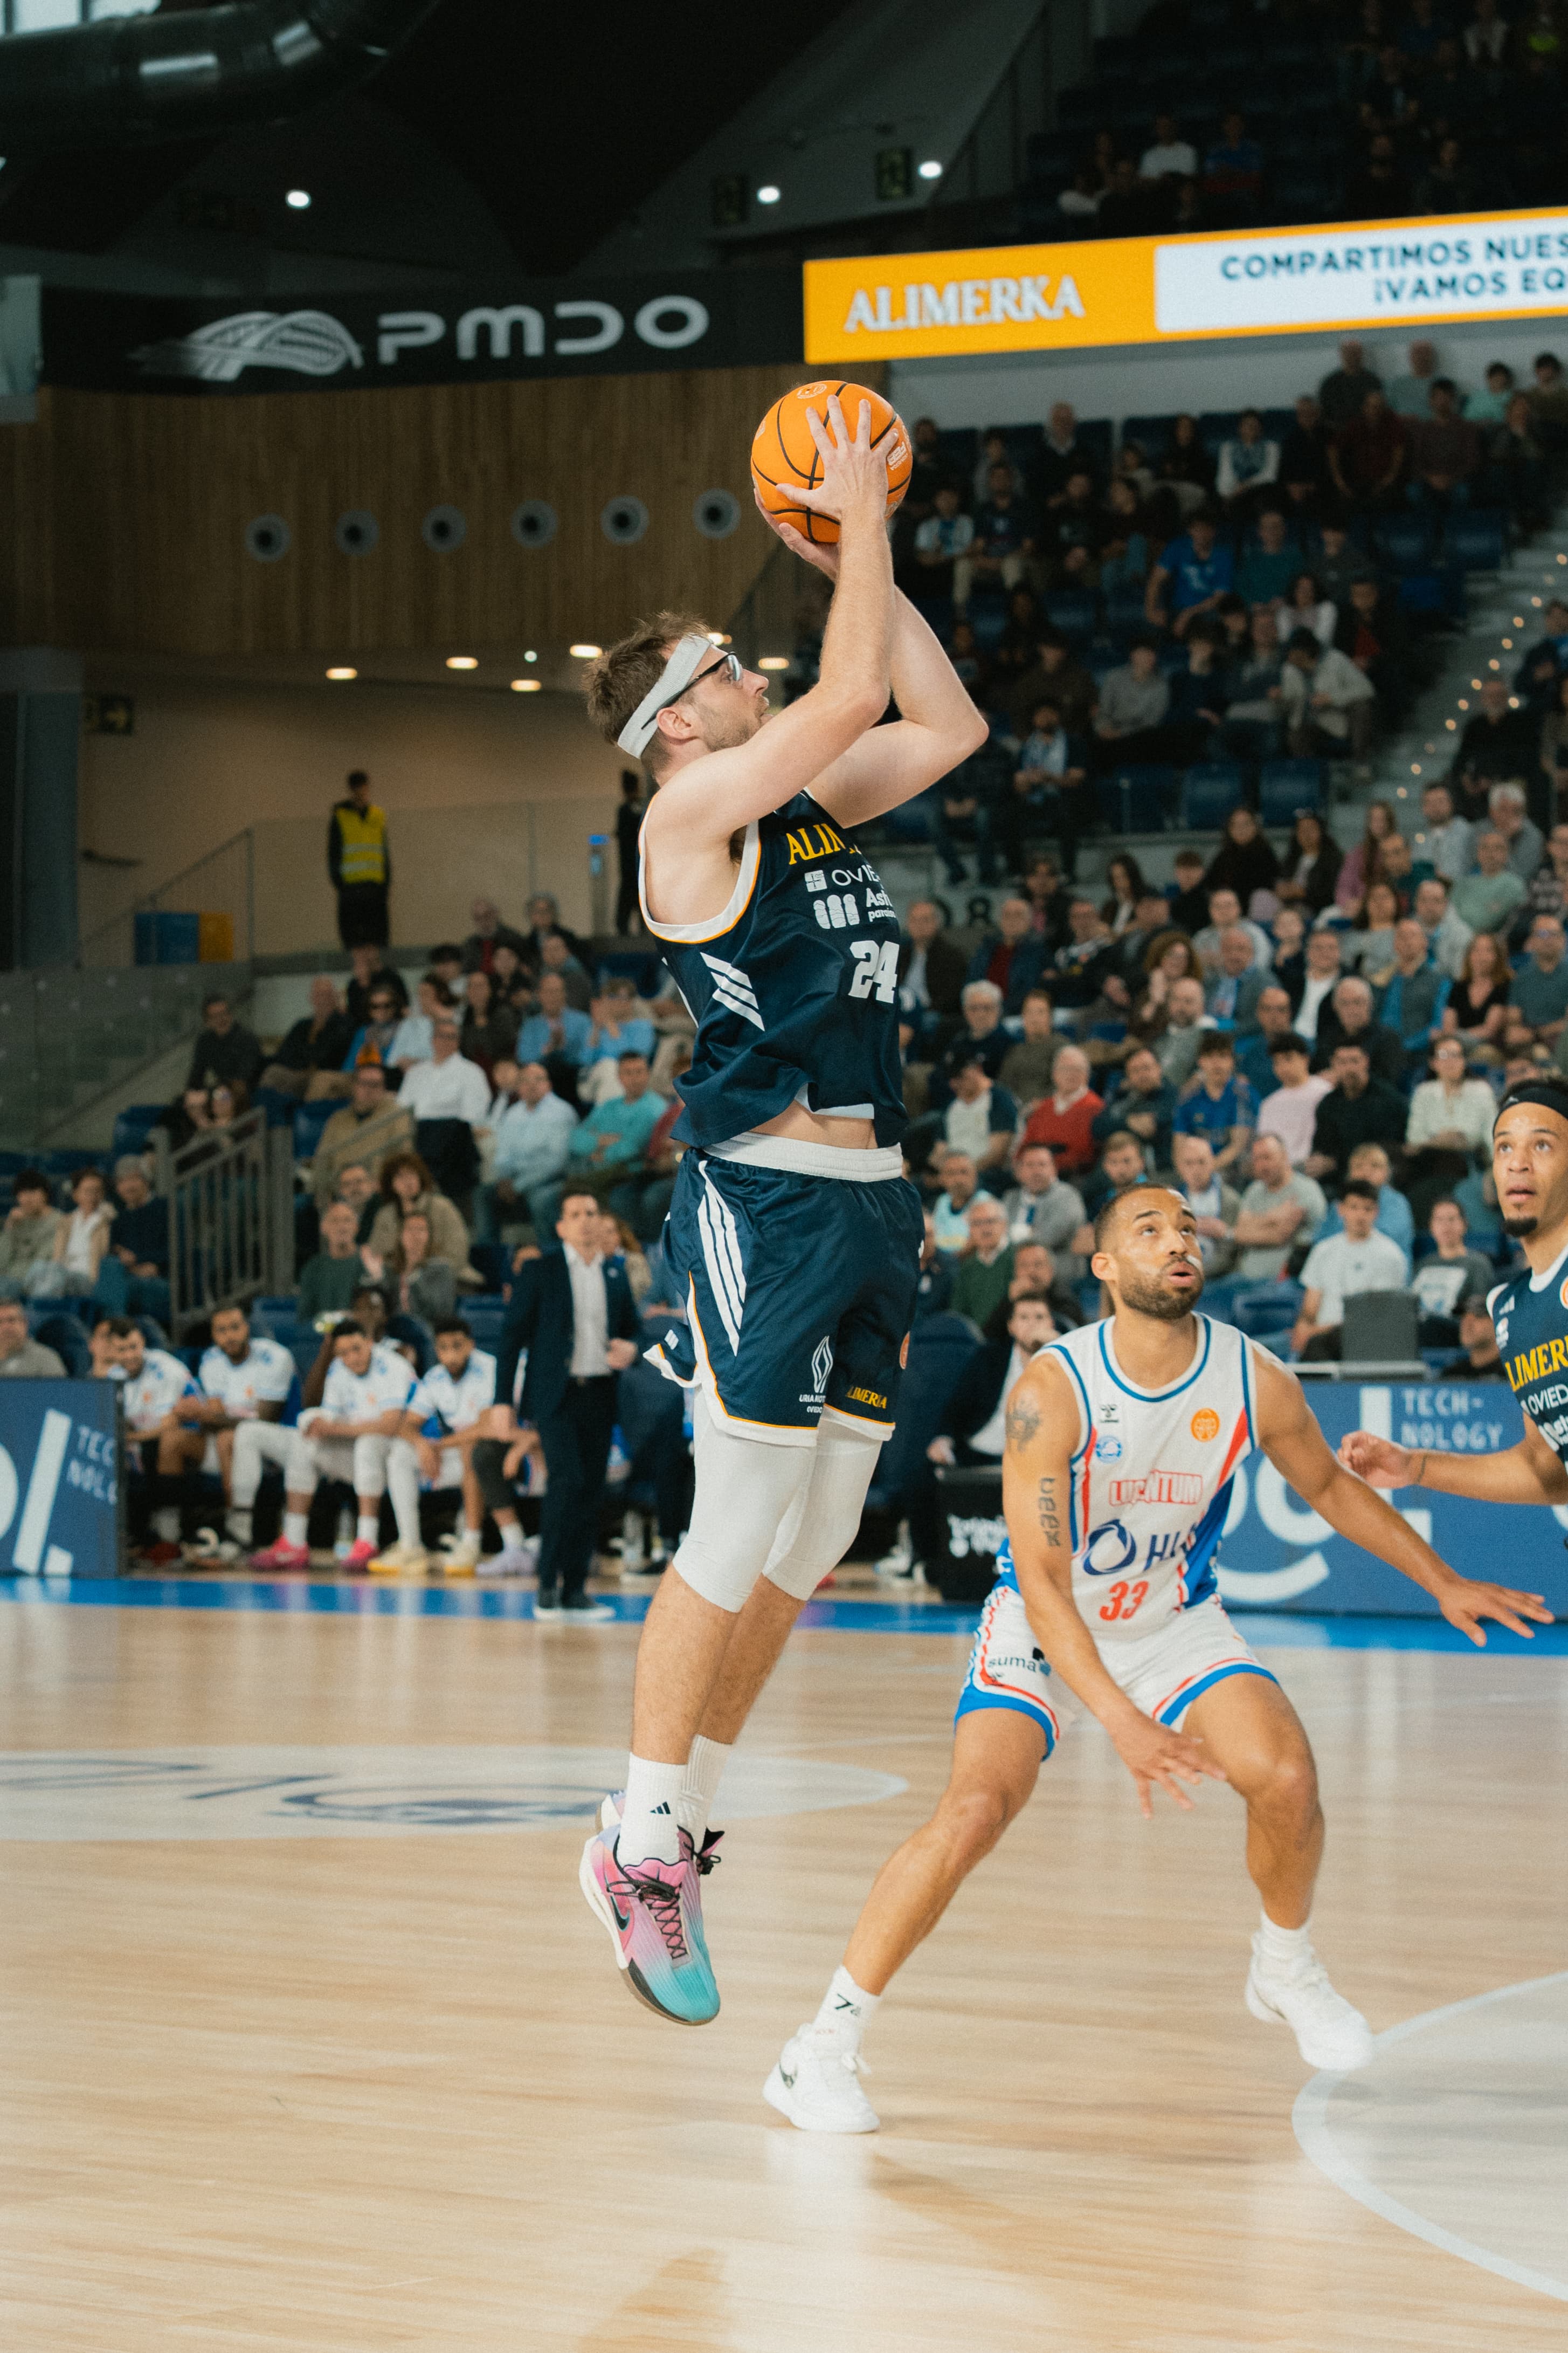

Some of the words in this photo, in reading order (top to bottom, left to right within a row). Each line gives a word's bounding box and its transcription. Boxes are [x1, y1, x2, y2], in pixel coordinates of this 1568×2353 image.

[1221, 239, 1471, 280] COMPARTIMOS
[1486, 232, 1568, 261] NUES
[1522, 269, 1566, 293] EQ
[845, 276, 1085, 332] ALIMERKA
[378, 295, 709, 366] PMDO
[832, 864, 881, 886] OVIE
[848, 940, 900, 1004] 24
[1505, 1335, 1568, 1392] LIMER
[1403, 1389, 1484, 1416] TECH-
[1402, 1422, 1503, 1450] NOLOGY
[1100, 1581, 1150, 1621] 33
